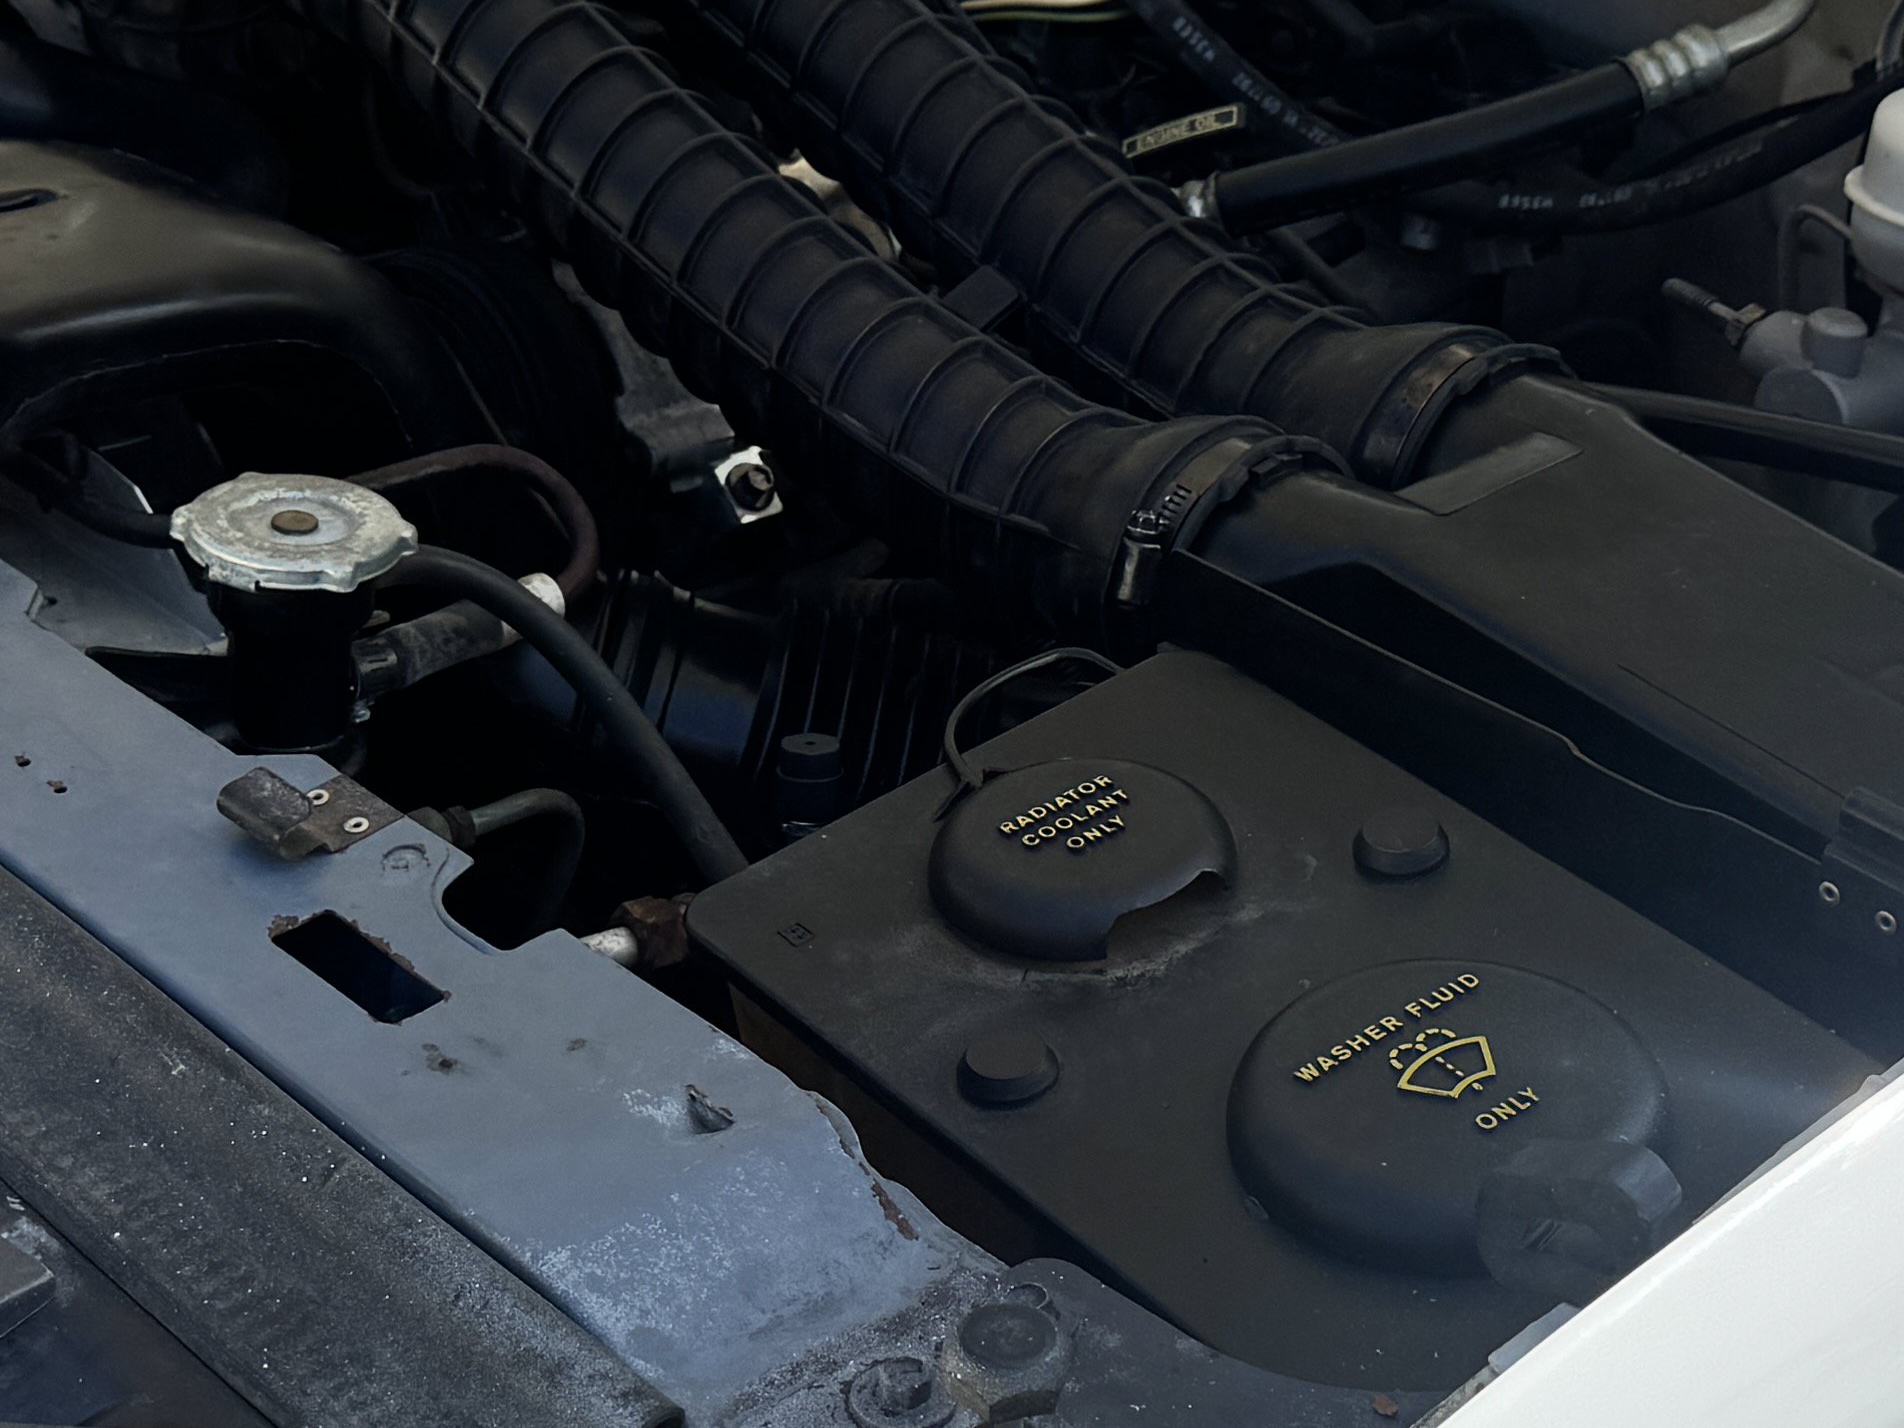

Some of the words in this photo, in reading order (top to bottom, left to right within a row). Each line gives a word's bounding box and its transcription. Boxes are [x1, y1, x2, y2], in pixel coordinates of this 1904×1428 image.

[998, 772, 1114, 836] RADIATOR
[1020, 787, 1131, 850] COOLANT
[1065, 813, 1128, 853] ONLY
[1294, 1014, 1403, 1085] WASHER
[1404, 972, 1482, 1019] FLUID
[1474, 1084, 1541, 1133] ONLY
